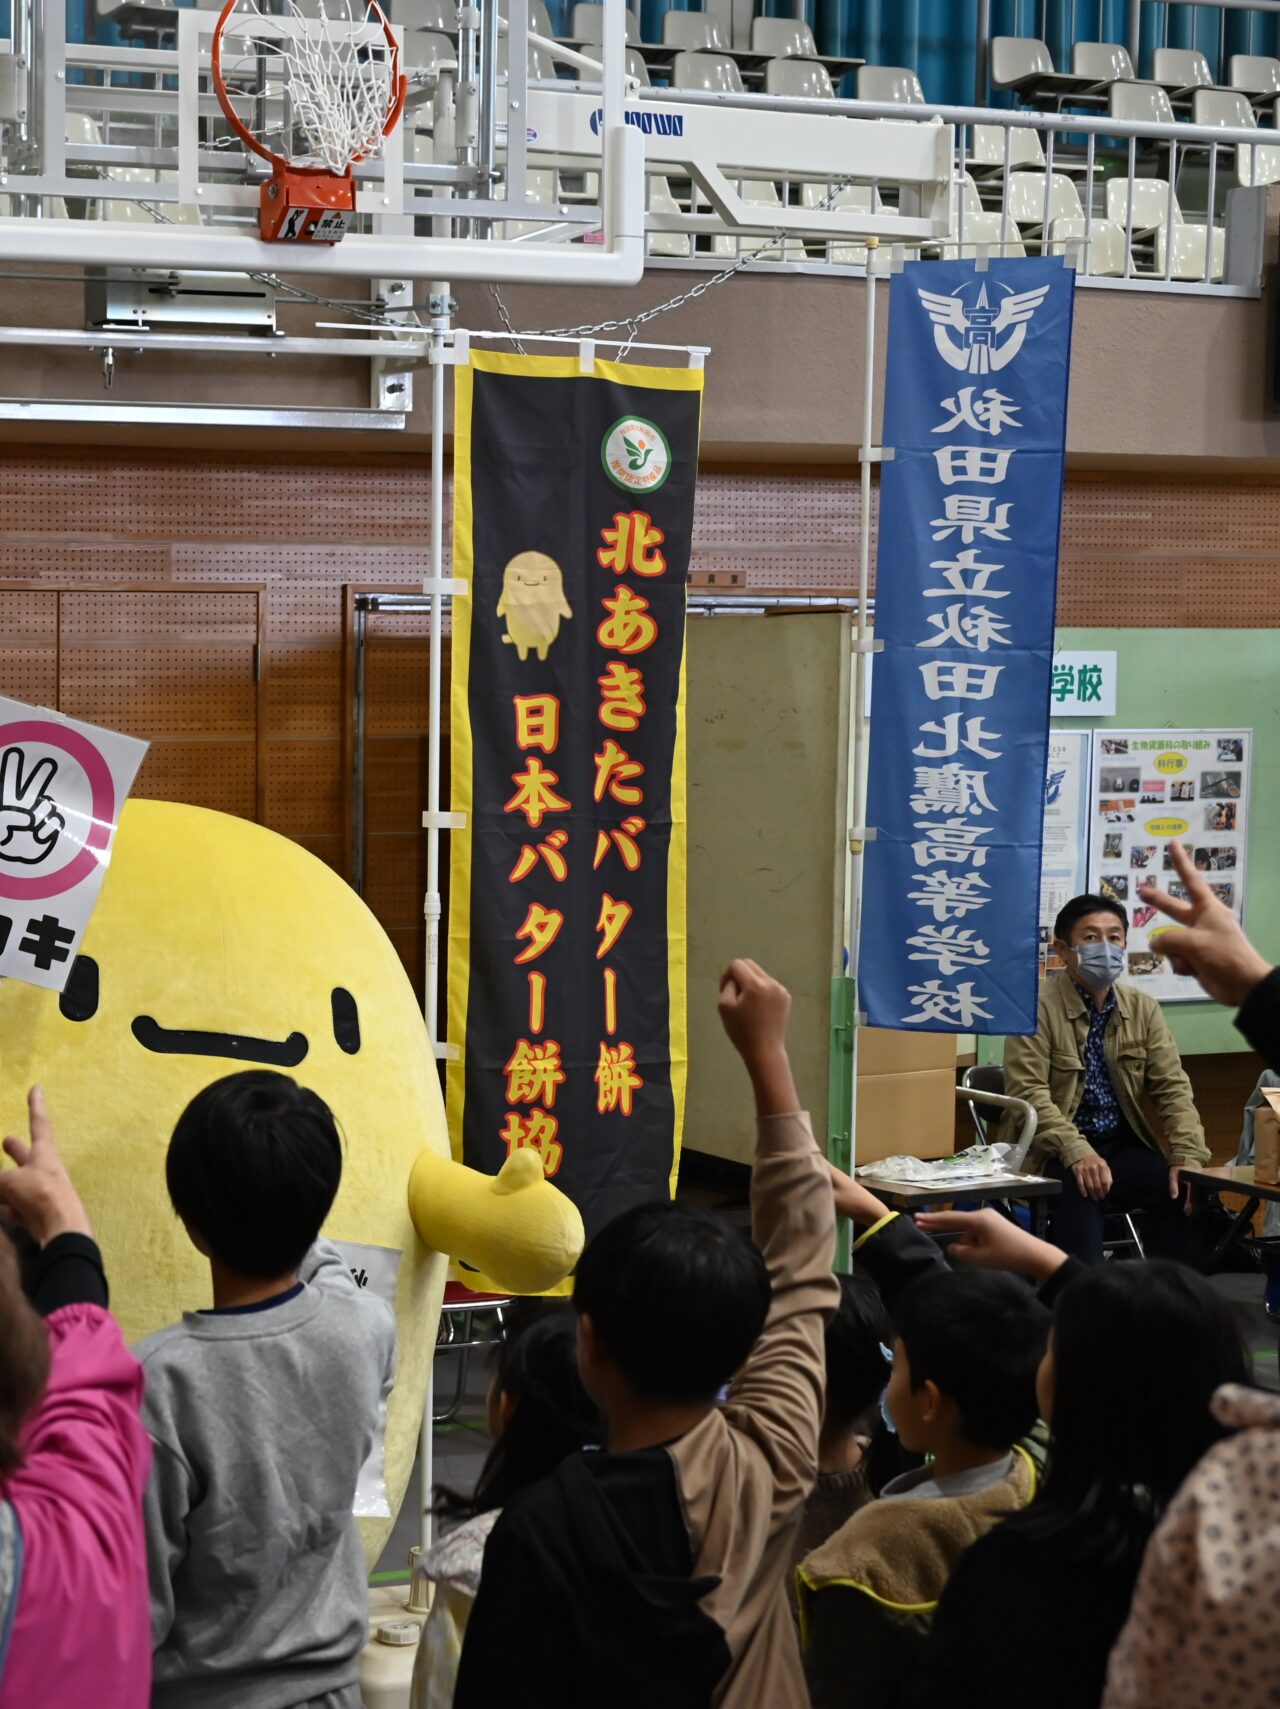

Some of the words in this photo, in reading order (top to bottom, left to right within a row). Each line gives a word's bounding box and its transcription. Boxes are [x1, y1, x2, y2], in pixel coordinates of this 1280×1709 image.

[321, 219, 346, 229] 禁止
[1051, 664, 1103, 702] 学校
[1158, 758, 1184, 769] 科行事
[594, 511, 667, 1117] 北あきたバター餅
